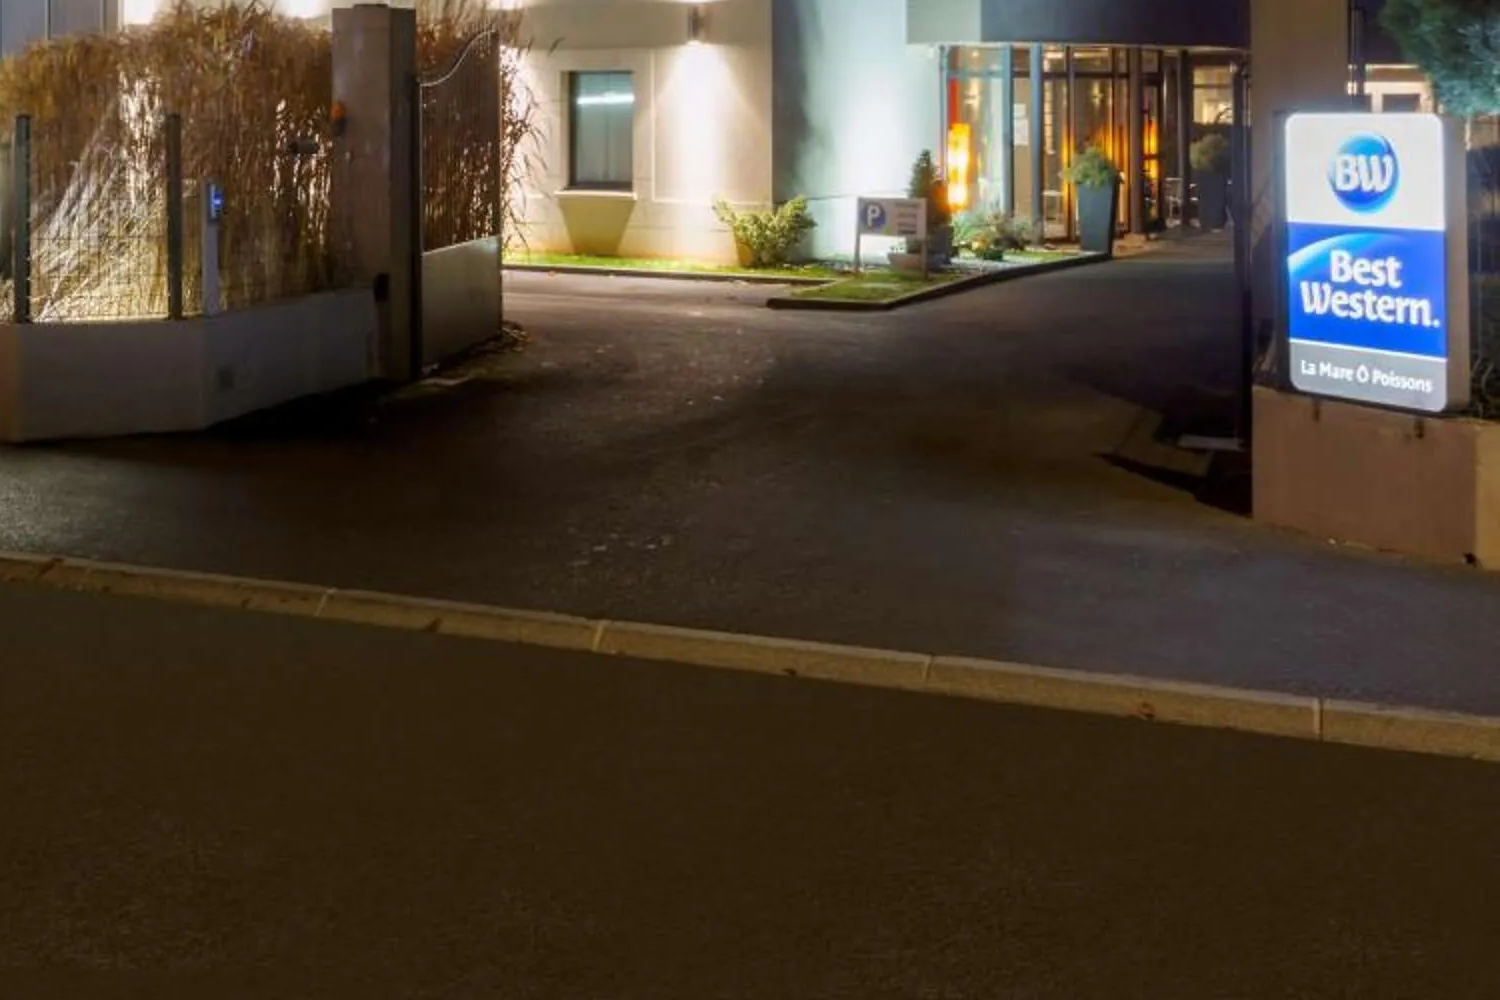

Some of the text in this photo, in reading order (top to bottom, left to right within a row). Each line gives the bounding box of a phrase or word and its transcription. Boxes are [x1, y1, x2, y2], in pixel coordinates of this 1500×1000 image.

[1334, 154, 1393, 192] BW
[1330, 249, 1402, 288] Best
[1301, 360, 1316, 376] La
[1319, 362, 1353, 380] Mare
[1372, 370, 1433, 393] Poissons
